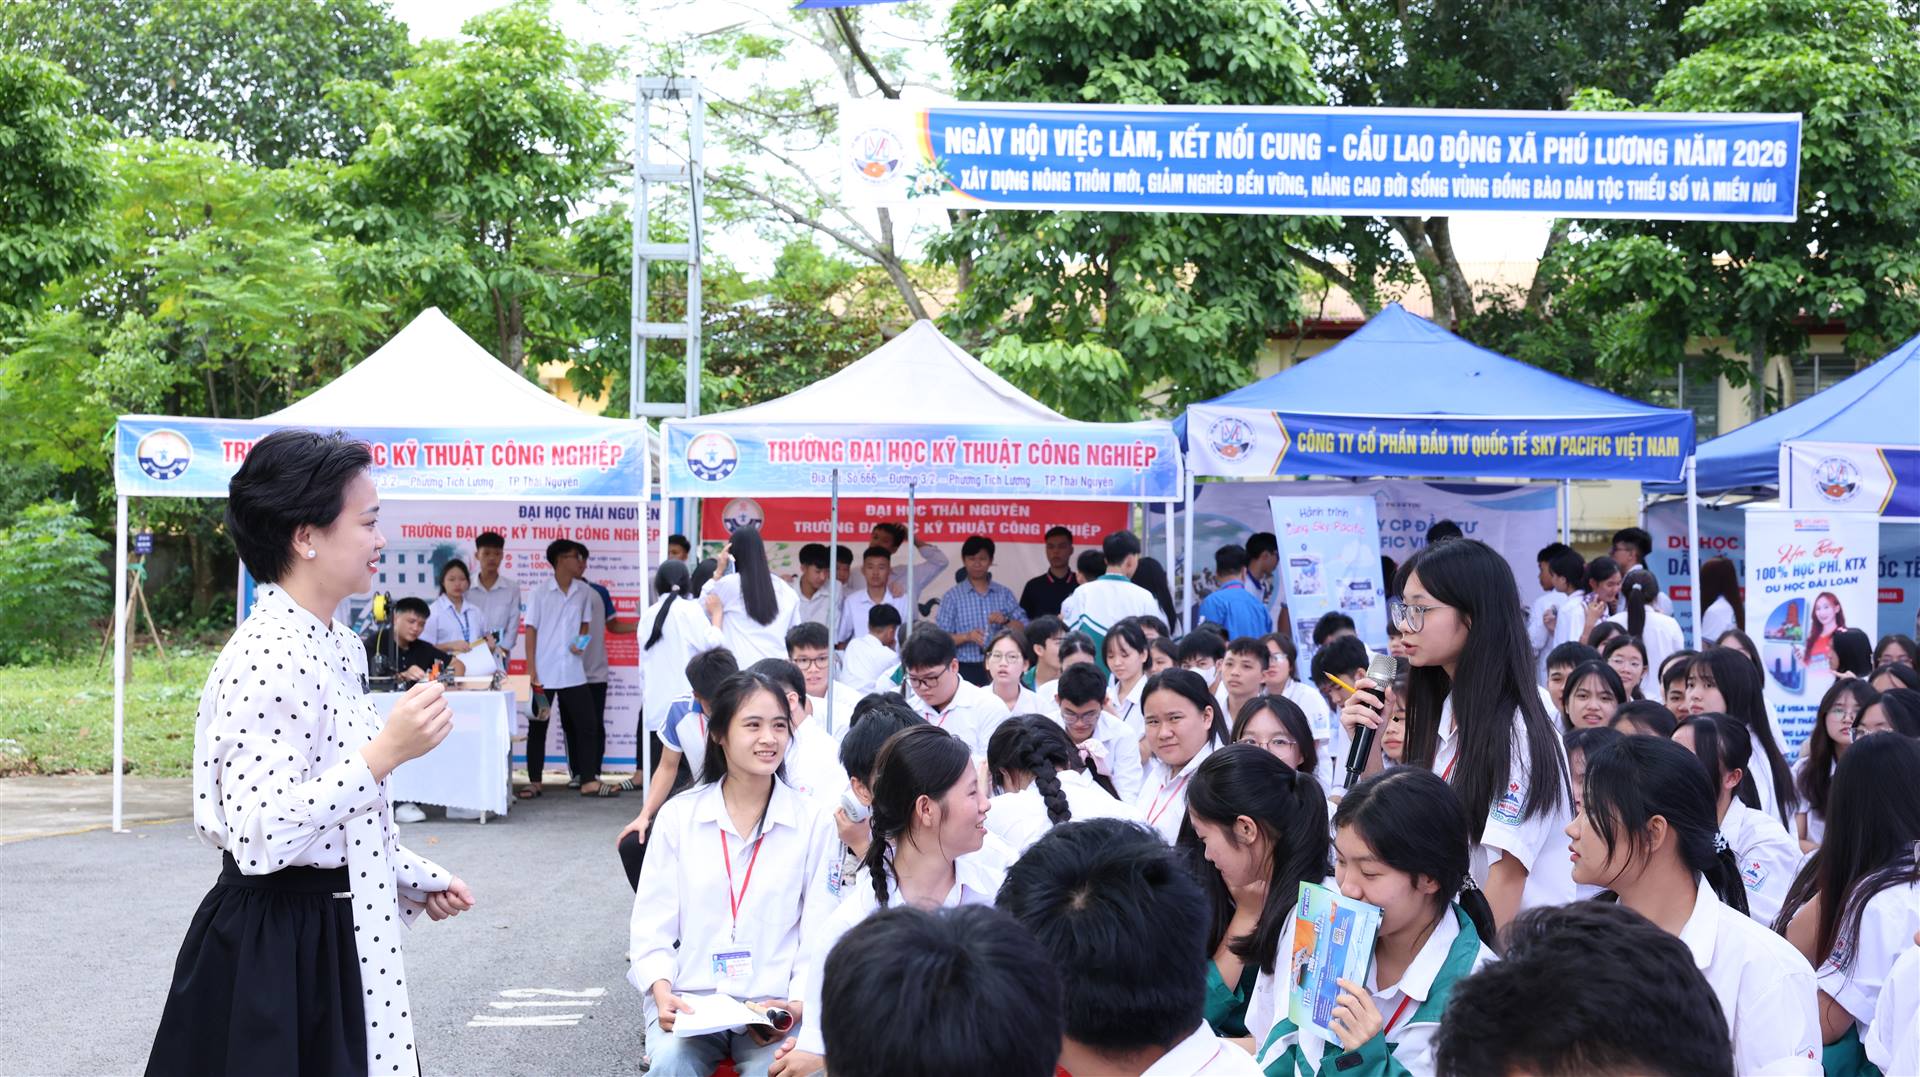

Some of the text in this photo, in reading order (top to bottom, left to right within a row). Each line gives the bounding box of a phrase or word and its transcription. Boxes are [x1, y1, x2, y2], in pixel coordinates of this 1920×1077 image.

[945, 122, 1005, 155] NGÀY
[1010, 122, 1048, 162] HỘI
[1054, 123, 1103, 163] VIỆC
[1109, 124, 1163, 162] LÀM,
[1169, 122, 1211, 159] KẾT
[1215, 122, 1254, 160] NỐI
[1260, 132, 1322, 161] CUNG
[1342, 124, 1388, 162] CẦU
[1393, 134, 1434, 162] LAO
[1440, 129, 1502, 169] ĐỘNG
[1507, 130, 1538, 164] XÃ
[1543, 131, 1589, 164] PHÚ
[1594, 135, 1668, 166] LƯƠNG
[1673, 132, 1727, 167] NĂM
[1731, 139, 1788, 168] 2026
[960, 165, 1777, 204] XÂY DỰNG NÔNG THÔN MỚI, GIẢM NGHÈO BỀN VỮNG, NÂNG CAO ĐỜI SỐNG VÙNG ĐỒNG BÀO DÂN TỘC THIỂU SỐ VÀ MIỀN NÚI
[1297, 426, 1679, 461] CÔNG TY CỔ PHẦN ĐẦU TƯ QUỐC TẾ SKY PACIFIC VIỆT NAM
[393, 439, 418, 466] KỸ
[424, 440, 485, 470] THUẬT
[492, 440, 545, 466] CÔNG
[551, 440, 622, 470] NGHIỆP
[768, 435, 1156, 472] TRƯỜNG ĐẠI HỌC KỸ THUẬT CÔNG NGHIỆP
[860, 472, 877, 484] 666
[1081, 475, 1114, 488] Nguyên
[519, 505, 540, 522] ĐẠI
[545, 506, 571, 522] HỌC
[575, 504, 604, 520] THÁI
[865, 504, 891, 519] ĐẠI
[930, 503, 964, 516] THÁI
[969, 503, 1030, 517] NGUYÊN
[400, 522, 452, 538] TRƯỜNG
[456, 525, 478, 541] ĐẠI
[511, 524, 528, 539] KỸ
[575, 525, 610, 541] CÔNG
[924, 520, 944, 534] KỸ
[948, 520, 995, 536] THUẬT
[999, 520, 1040, 535] CÔNG
[1390, 519, 1412, 532] CP
[1699, 535, 1739, 552] HỌC
[1756, 565, 1788, 581] 100%
[1793, 563, 1815, 579] HỌC
[1845, 556, 1867, 570] KTX
[1765, 576, 1858, 593] DU HỌC ĐÀI LOAN
